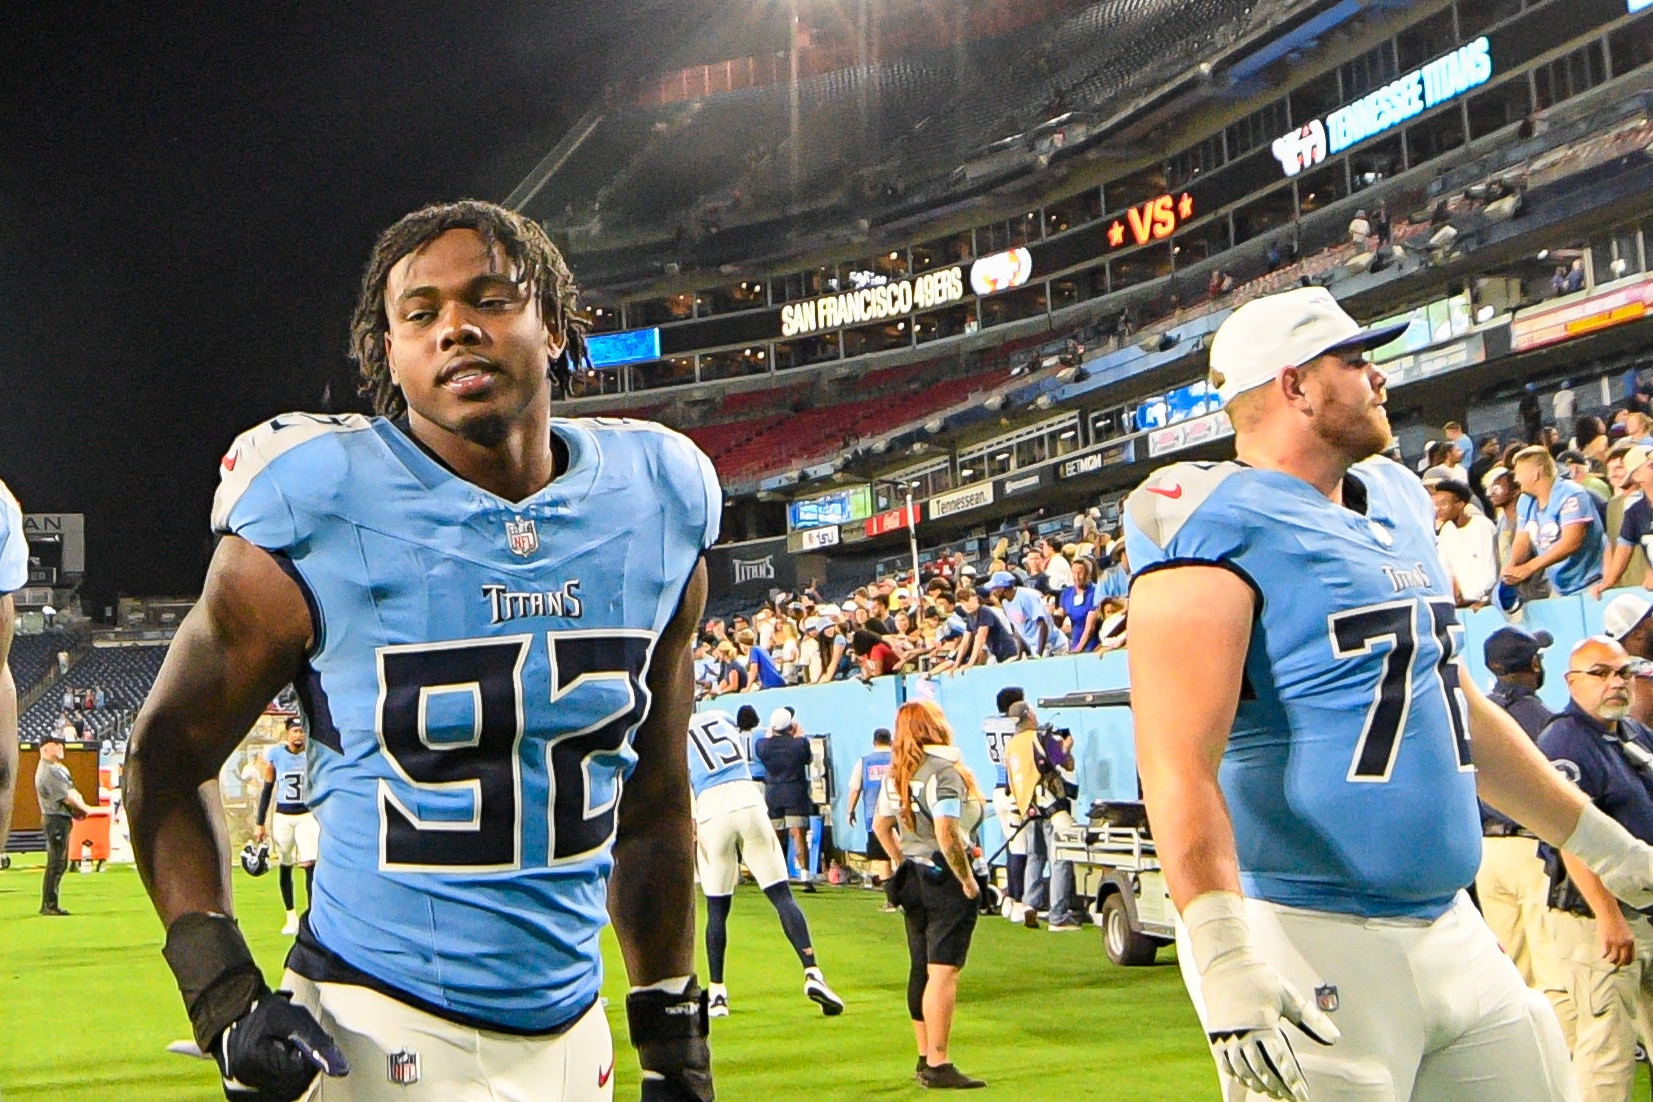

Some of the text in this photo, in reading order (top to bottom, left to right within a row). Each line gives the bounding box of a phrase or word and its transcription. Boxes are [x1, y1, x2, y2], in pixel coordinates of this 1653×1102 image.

[1326, 35, 1492, 155] TENNESSEE TITANS
[1127, 194, 1175, 246] VS
[781, 266, 964, 336] SAN FRANCISCO 49ERS
[481, 579, 583, 625] TITANS
[375, 628, 659, 873] 92
[687, 719, 744, 772] 15
